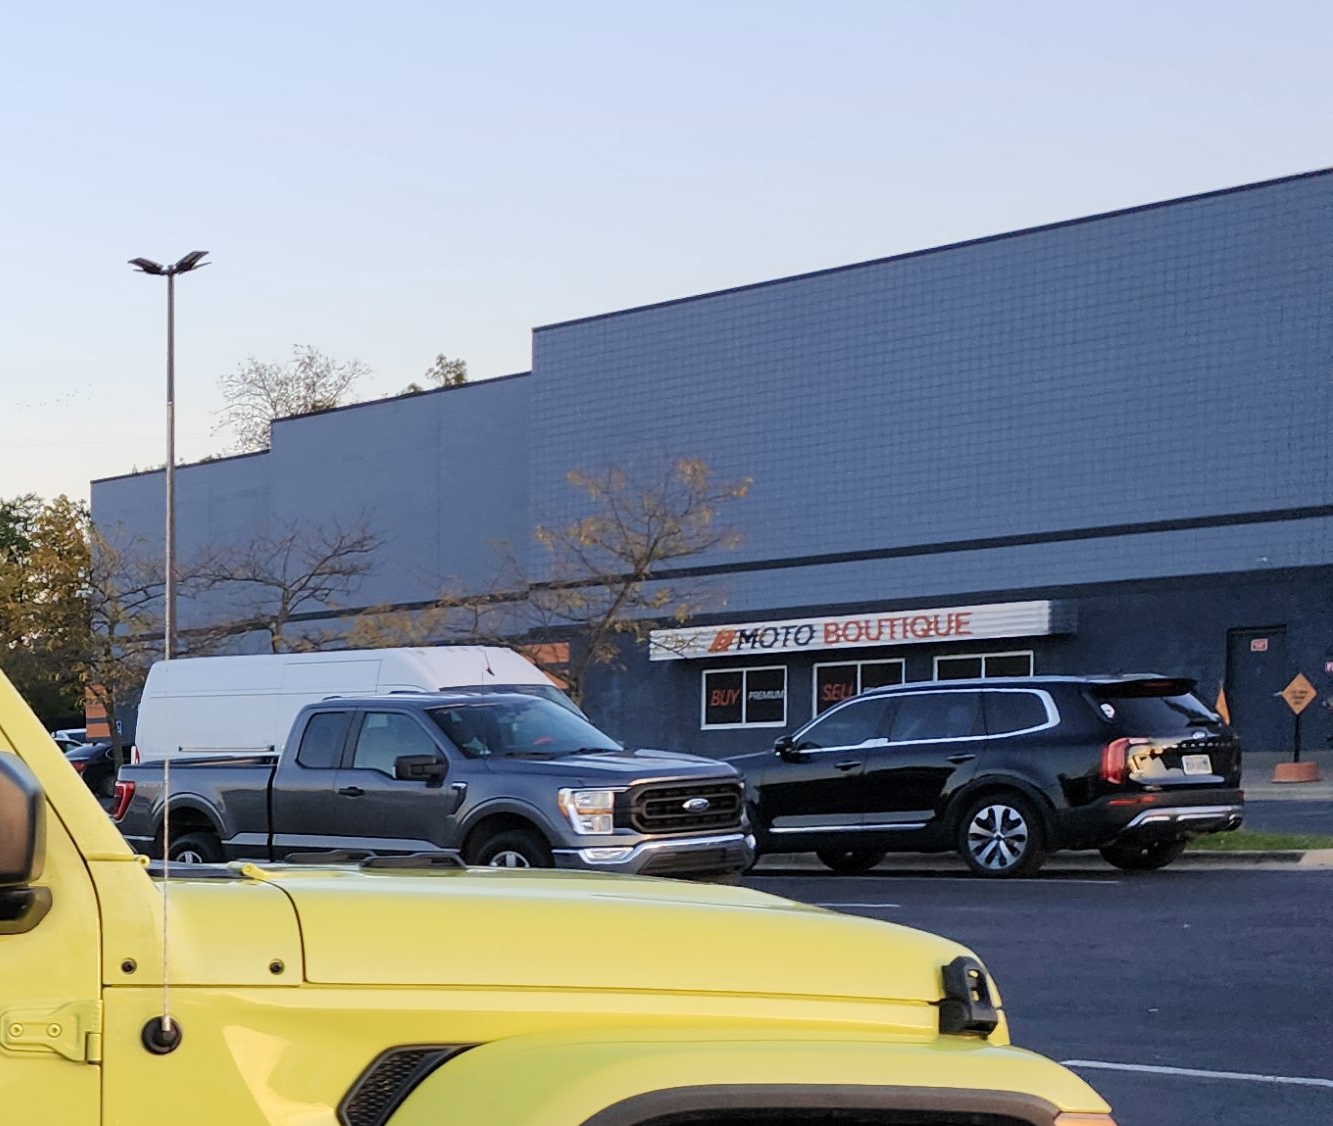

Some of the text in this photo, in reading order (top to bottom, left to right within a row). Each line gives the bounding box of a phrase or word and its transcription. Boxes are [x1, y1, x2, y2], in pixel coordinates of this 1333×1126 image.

[737, 612, 972, 649] MOTO BOUTIQUE
[710, 689, 741, 707] BUY
